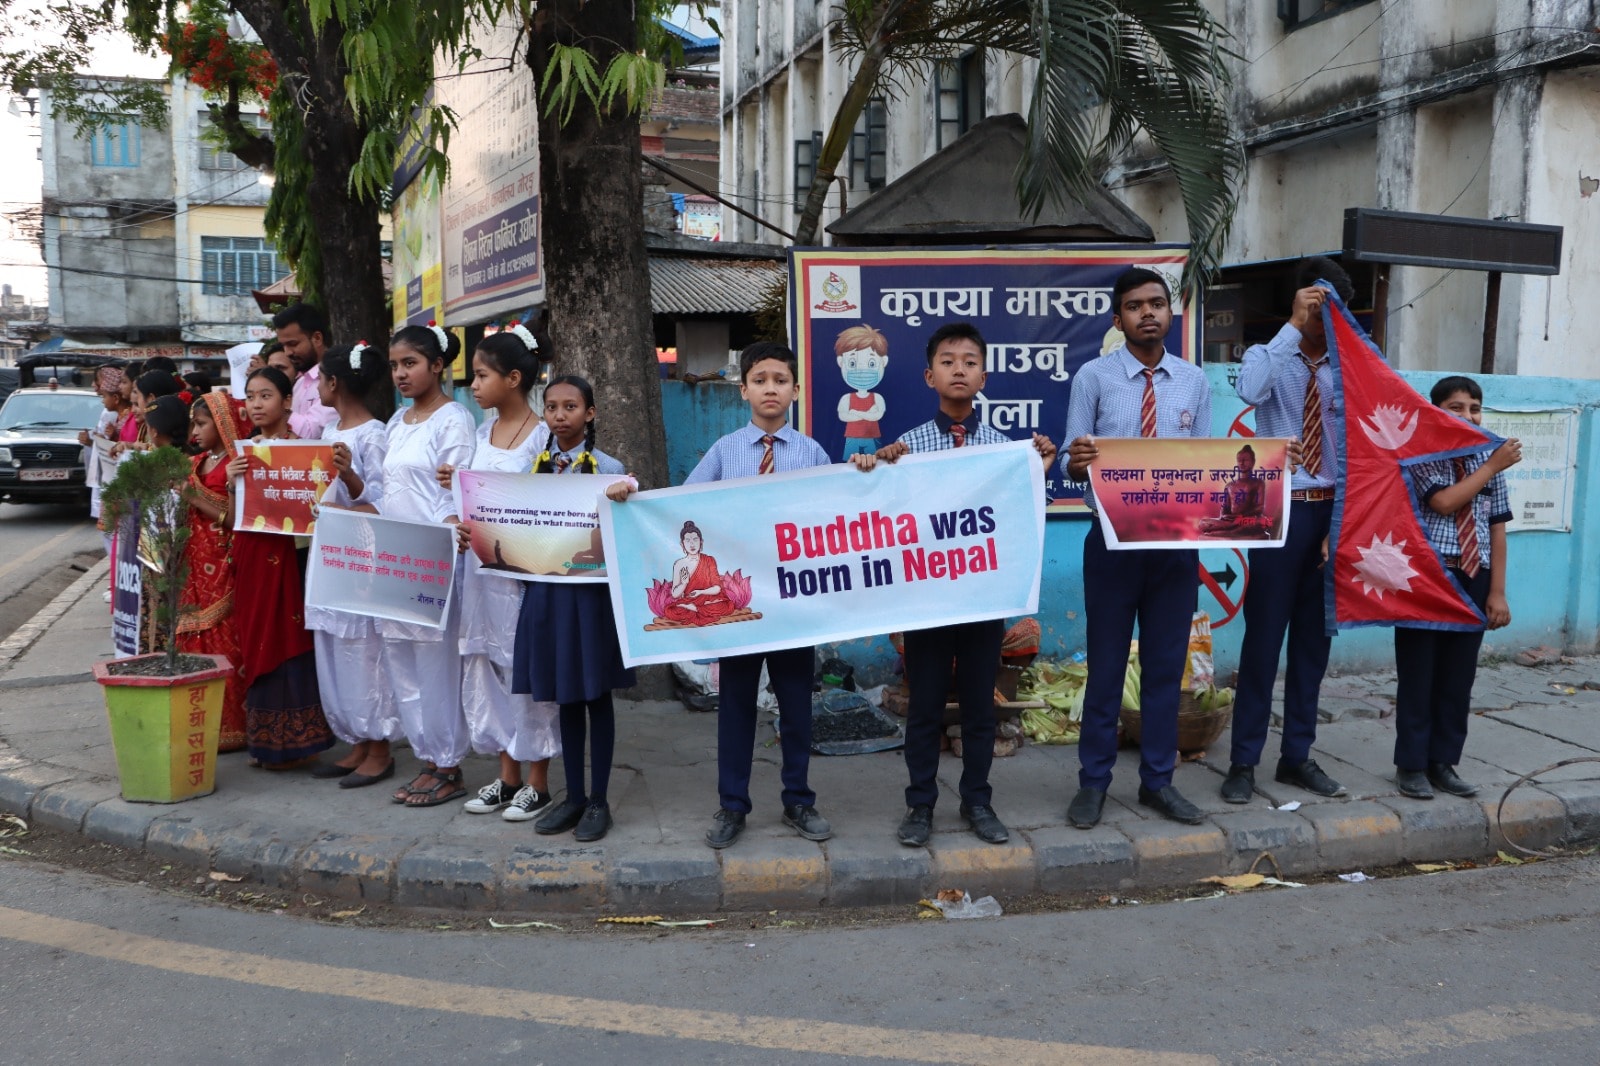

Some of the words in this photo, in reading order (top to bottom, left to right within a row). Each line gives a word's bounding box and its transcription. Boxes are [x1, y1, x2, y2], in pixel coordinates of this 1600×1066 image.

[880, 287, 993, 326] कृपया
[1006, 287, 1114, 319] मास्क
[1101, 469, 1146, 483] लक्ष्यमा
[1151, 469, 1204, 486] पुग्नुभन्दा
[1209, 466, 1242, 484] जरुरी
[1121, 486, 1170, 506] राम्रोसँग
[1174, 490, 1204, 504] यात्रा
[470, 514, 485, 522] What
[510, 518, 532, 526] today
[504, 508, 538, 516] morning
[774, 510, 919, 562] Buddha
[929, 506, 996, 540] was
[118, 560, 140, 595] 2023
[777, 563, 852, 599] born
[861, 555, 893, 588] in
[902, 537, 998, 582] Nepal
